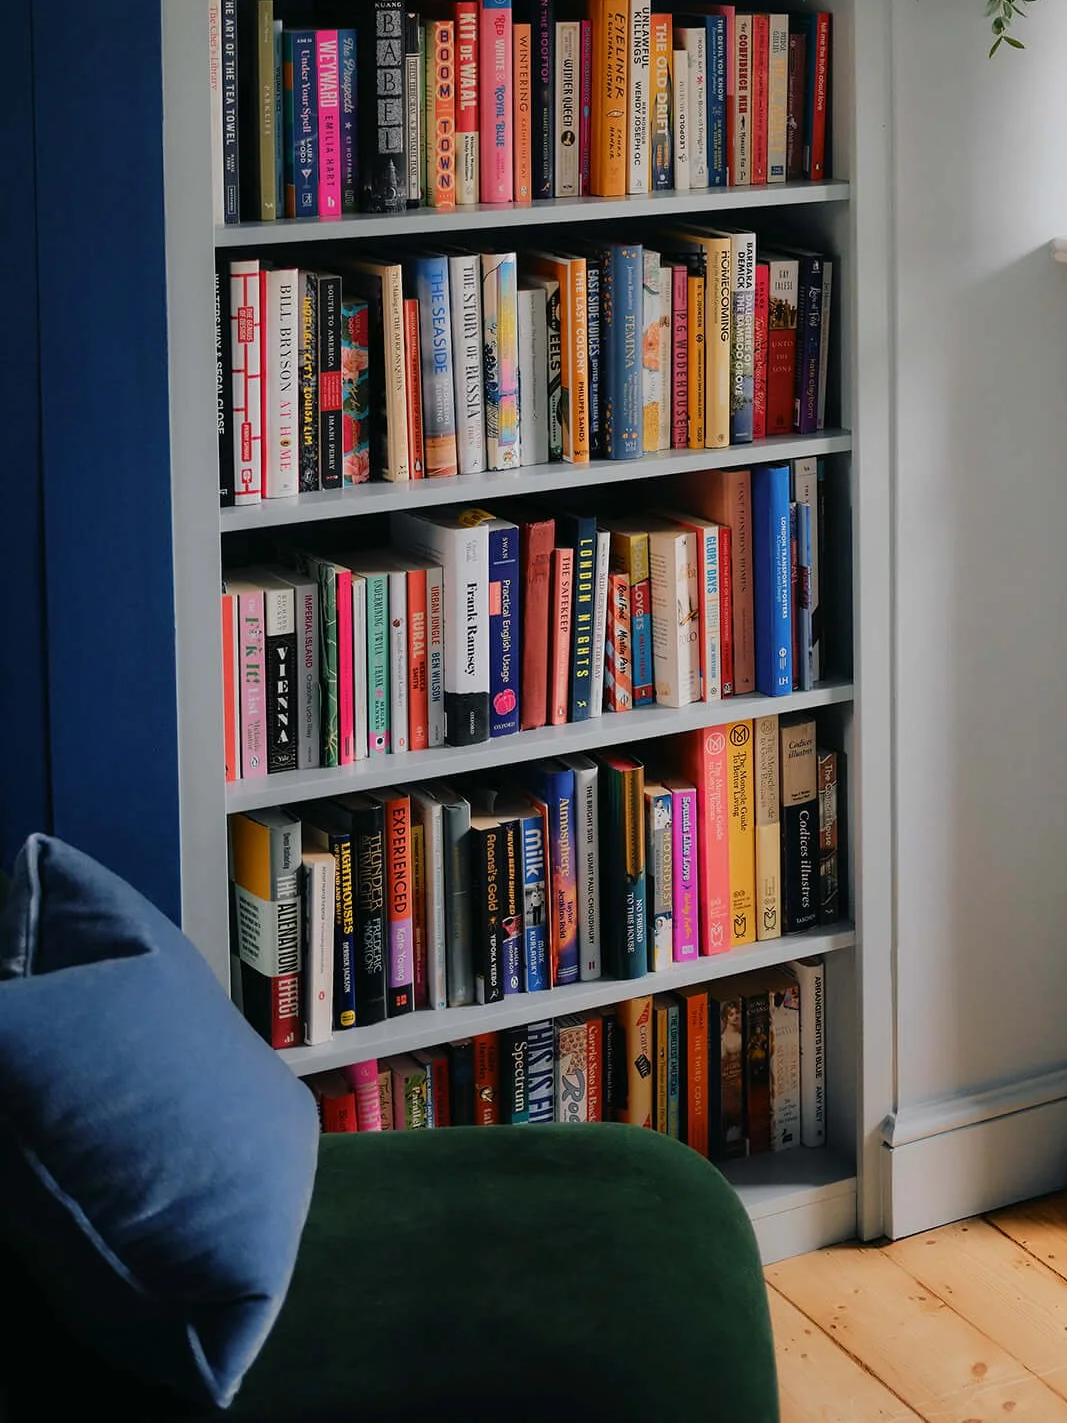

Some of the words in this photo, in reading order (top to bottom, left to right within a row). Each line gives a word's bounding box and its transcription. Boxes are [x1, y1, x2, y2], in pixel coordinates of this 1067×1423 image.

[225, 19, 234, 39] ART
[459, 12, 476, 42] KIT
[634, 11, 642, 64] KILLINGS
[642, 7, 650, 68] UNLAWFUL
[656, 23, 668, 52] THE
[225, 43, 235, 56] OF
[343, 37, 354, 57] The
[460, 44, 470, 60] DE
[615, 13, 626, 99] EYELINER
[226, 60, 235, 80] THE
[300, 50, 310, 82] Under
[319, 40, 338, 108] WEYWARD
[383, 13, 400, 151] BABEL
[519, 35, 528, 113] WINTERING
[656, 56, 669, 82] OLD
[226, 85, 235, 105] TEA
[301, 82, 311, 107] Your
[342, 58, 356, 115] Prospects
[460, 62, 478, 111] WAAL
[226, 109, 236, 146] TOWEL
[301, 107, 312, 134] Spell
[657, 92, 670, 138] DRIFT
[324, 116, 334, 152] EMILIA
[326, 158, 336, 187] HART
[464, 264, 475, 289] THE
[588, 270, 599, 296] EAST
[738, 251, 746, 289] DEMICK
[279, 285, 292, 322] BILL
[430, 272, 445, 308] THE
[588, 296, 600, 319] SIDE
[464, 293, 478, 340] STORY
[432, 310, 448, 374] SEASIDE
[466, 346, 478, 361] OF
[549, 334, 561, 371] EELS
[589, 320, 600, 356] VOICES
[624, 314, 636, 368] FEMINA
[280, 328, 292, 393] BRYSON
[280, 400, 292, 418] AT
[465, 366, 480, 418] RUSSIA
[561, 556, 570, 578] THE
[632, 539, 646, 579] Book
[706, 536, 718, 566] GLORY
[578, 539, 593, 603] LONDON
[706, 569, 718, 594] DAYS
[304, 594, 314, 635] IMPERIAL
[430, 586, 440, 614] URBAN
[466, 582, 478, 622] Frank
[502, 579, 512, 618] Practical
[560, 580, 570, 633] SAFEKEEP
[634, 582, 646, 631] Lovers
[413, 611, 424, 658] RURAL
[430, 616, 440, 646] JUNGLE
[500, 620, 512, 652] English
[576, 614, 592, 679] NIGHTS
[304, 636, 314, 668] ISLAND
[432, 652, 440, 670] BEN
[464, 624, 478, 676] Ramsey
[500, 654, 511, 683] Usage
[432, 672, 440, 702] WILSON
[558, 798, 571, 877] Atmosphere
[800, 810, 811, 857] Codices
[370, 831, 382, 910] THUNDER
[392, 808, 408, 912] EXPERIENCED
[486, 833, 498, 882] Anansi's
[278, 875, 298, 898] THE
[341, 841, 353, 935] LIGHTHOUSES
[488, 883, 500, 912] Gold
[628, 892, 635, 902] TO
[800, 860, 812, 908] illustres
[636, 898, 643, 911] NO
[278, 903, 299, 975] ALIENATION
[636, 912, 644, 942] FRIEND
[278, 978, 299, 1020] EFFECT
[588, 1026, 598, 1061] Carrie
[694, 1035, 702, 1052] THE
[512, 1041, 527, 1112] Spectrum
[588, 1062, 597, 1084] Soto
[694, 1056, 702, 1082] THIRD
[588, 1086, 597, 1095] Is
